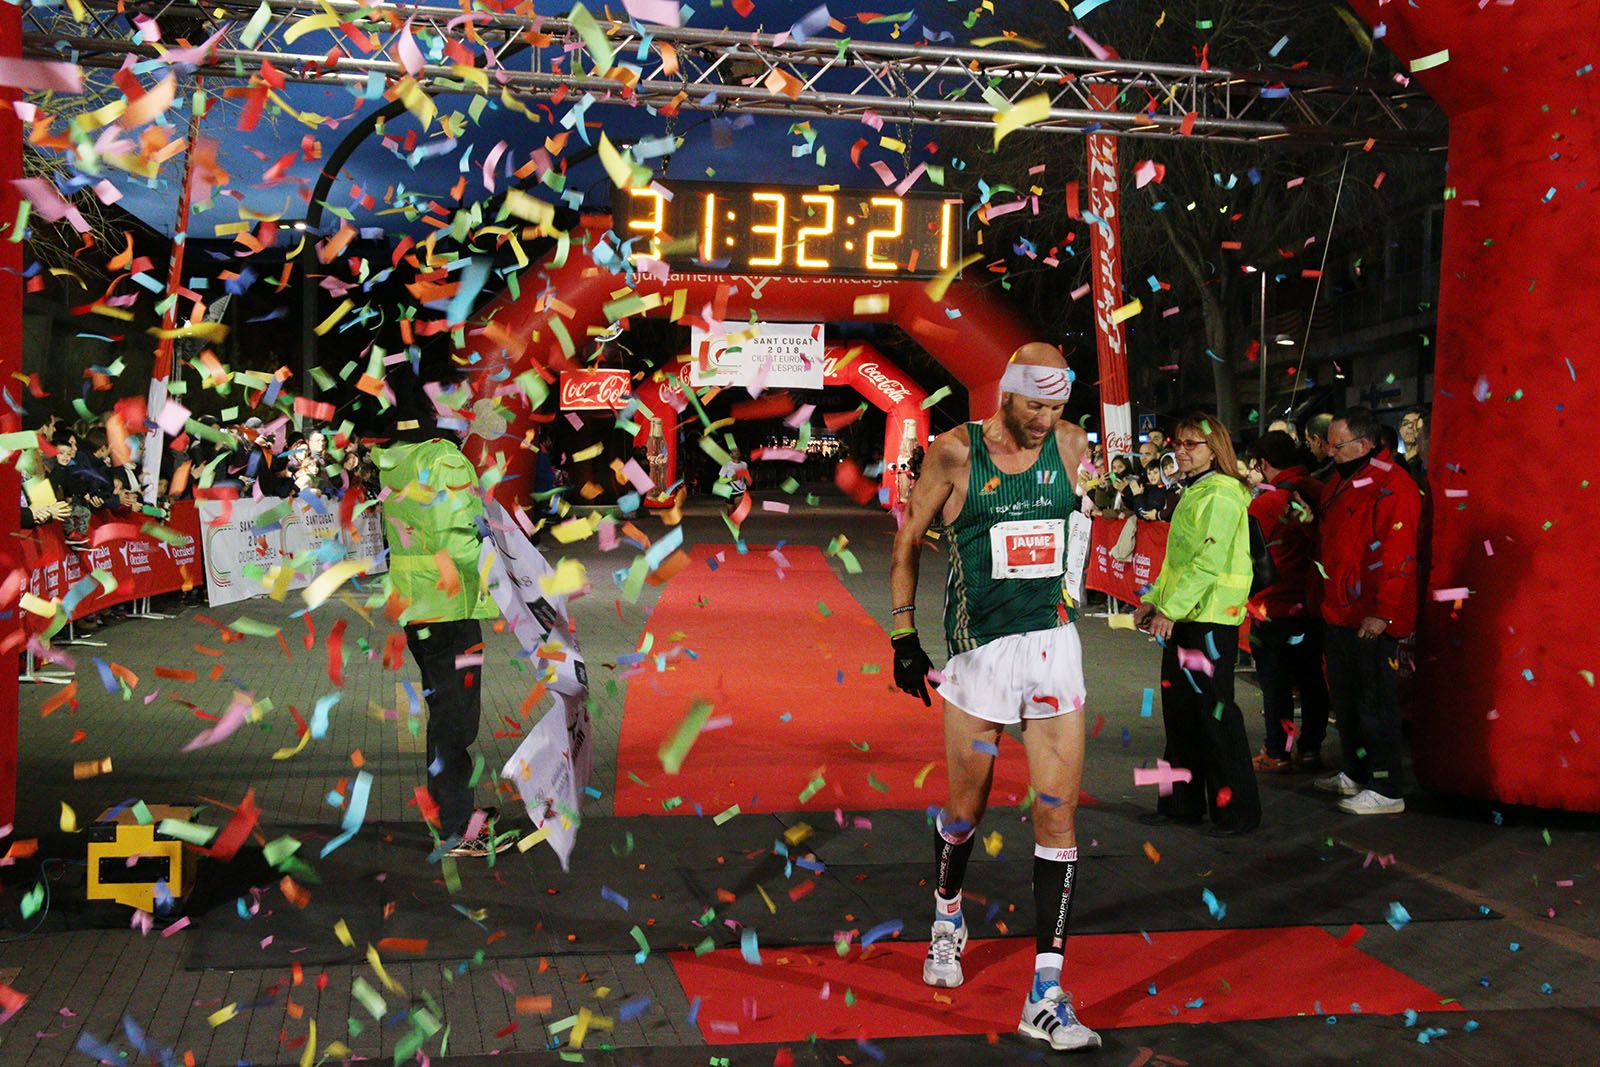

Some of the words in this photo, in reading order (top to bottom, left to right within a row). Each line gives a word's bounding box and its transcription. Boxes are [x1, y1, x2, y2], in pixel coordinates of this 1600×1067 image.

[753, 337, 778, 345] SANT
[782, 337, 814, 346] CUGAT
[767, 346, 800, 354] 2018
[751, 354, 777, 363] CIUTT
[778, 355, 815, 364] EUROA
[771, 364, 808, 372] L'ESPOR
[1011, 535, 1051, 551] JAUME
[1029, 549, 1037, 562] 1
